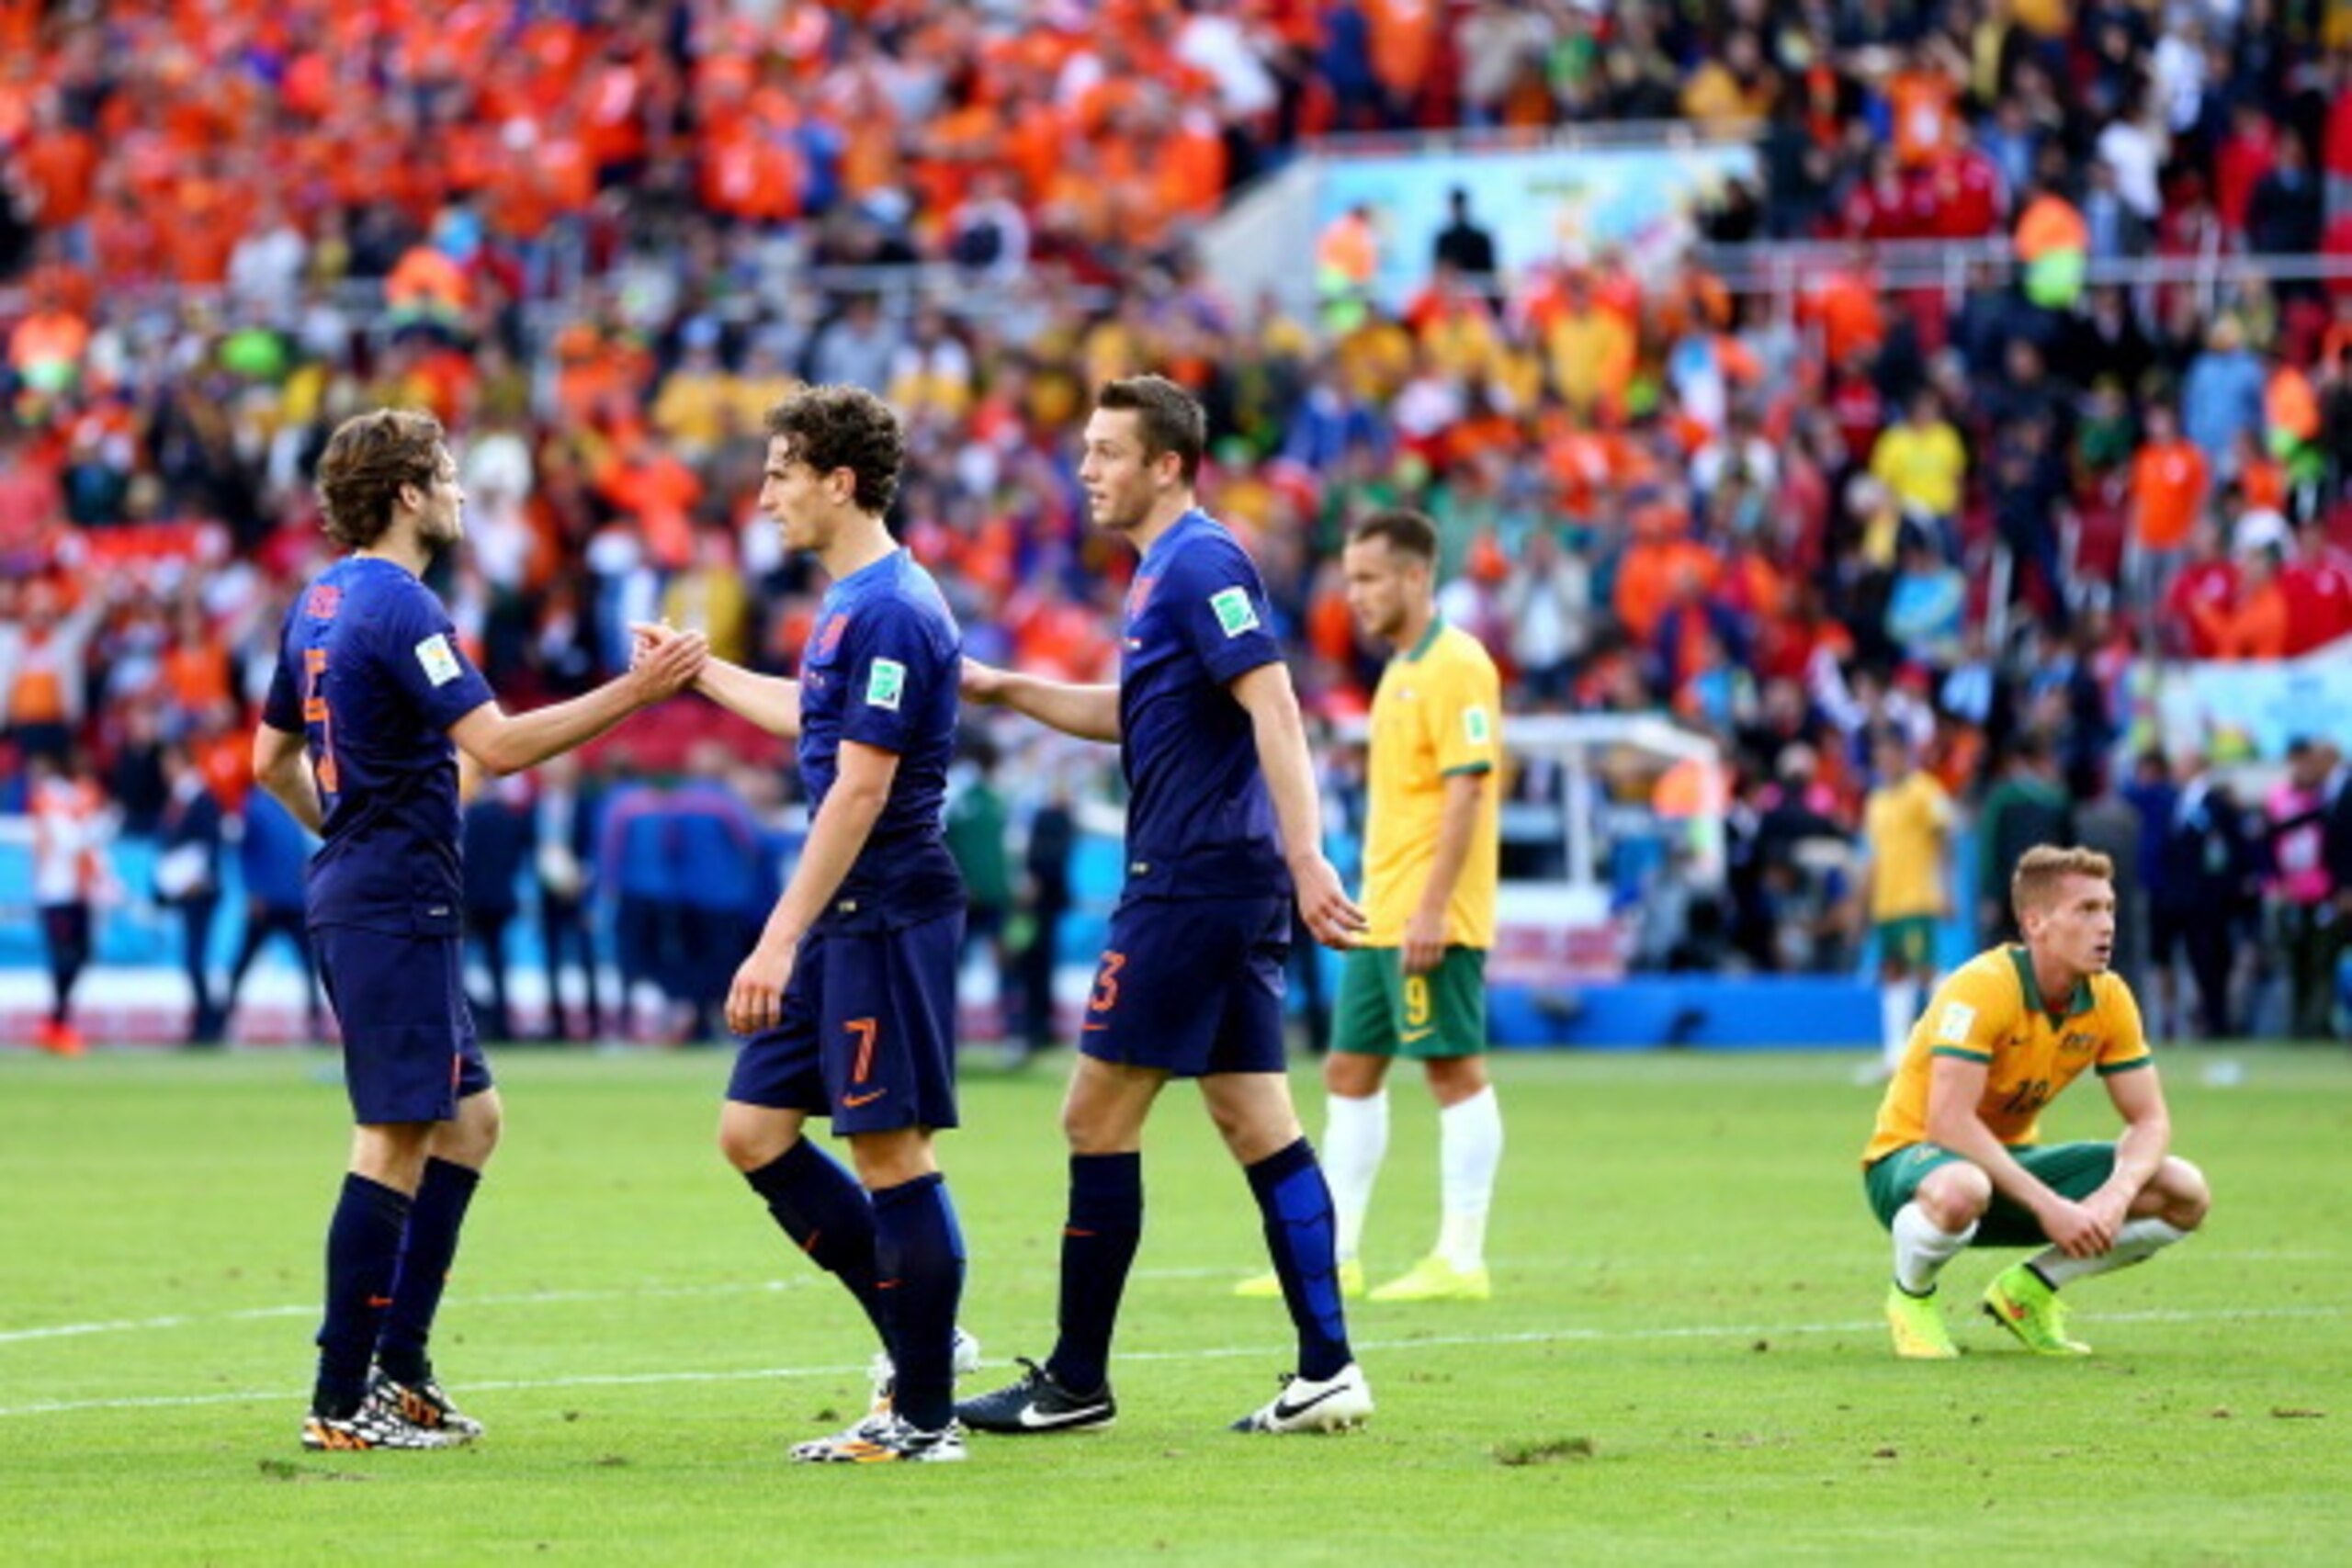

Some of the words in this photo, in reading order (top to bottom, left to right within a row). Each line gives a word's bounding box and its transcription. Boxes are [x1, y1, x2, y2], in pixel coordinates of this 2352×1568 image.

[1091, 951, 1125, 1011] 3
[1404, 976, 1428, 1025] 9
[843, 1017, 876, 1083] 7
